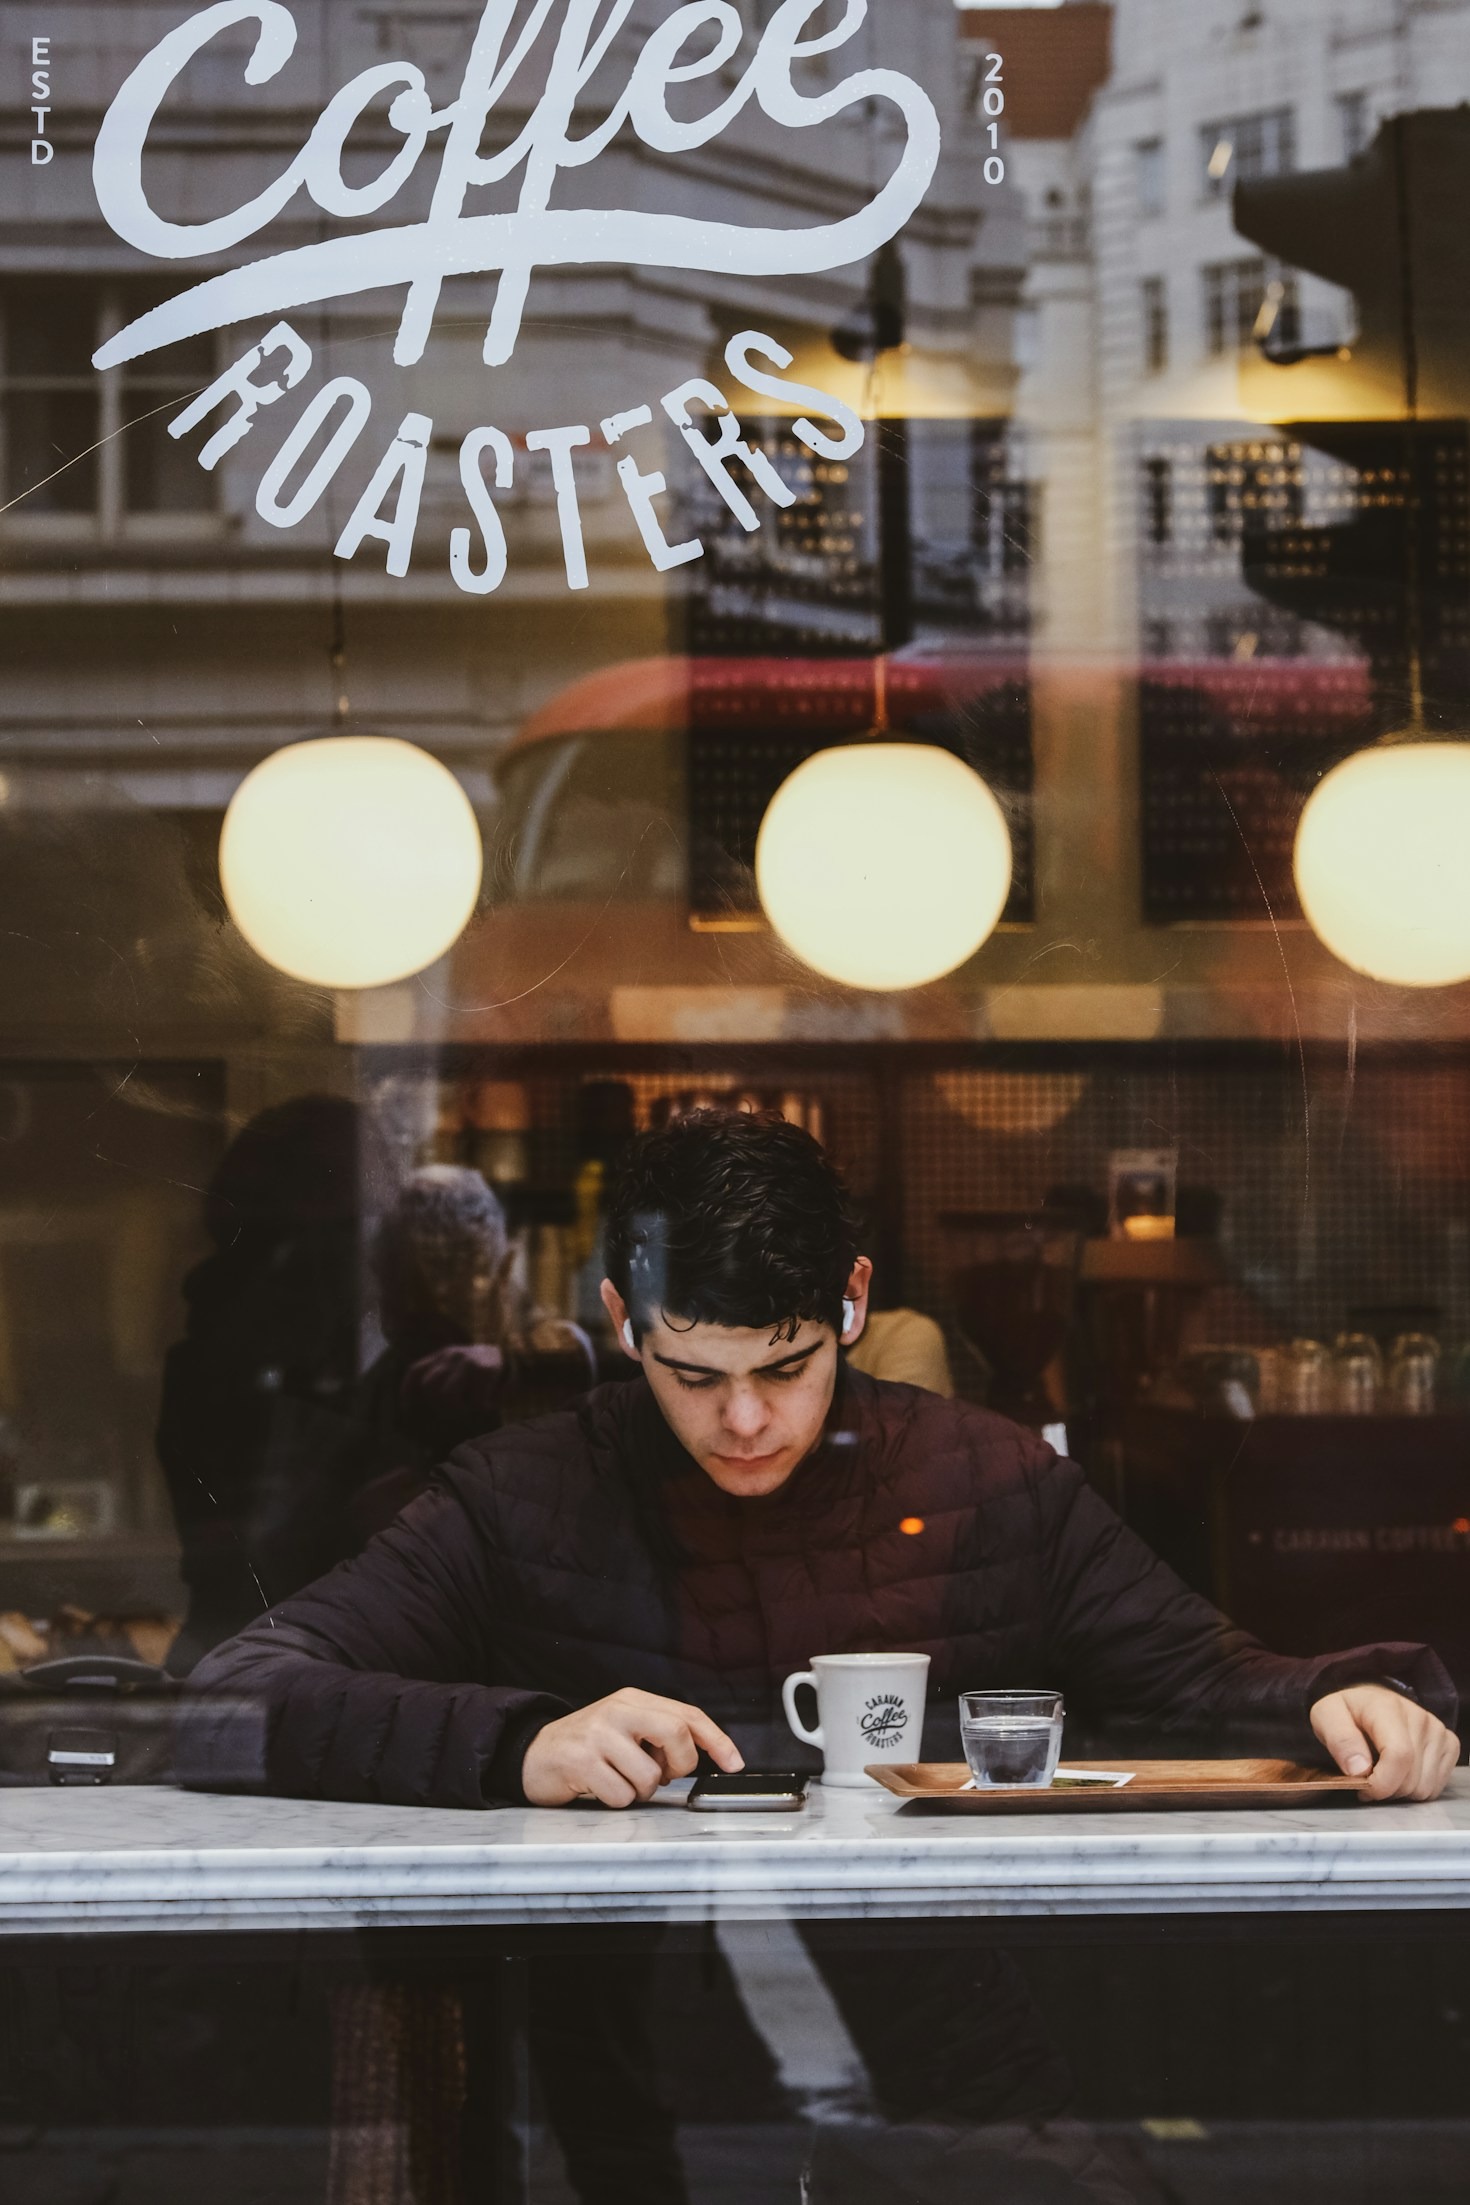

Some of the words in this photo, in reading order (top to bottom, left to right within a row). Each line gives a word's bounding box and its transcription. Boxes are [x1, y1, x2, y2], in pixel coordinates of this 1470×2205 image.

[30, 37, 54, 165] ESTD
[983, 53, 1005, 185] 2010
[92, 0, 942, 371] Coffee
[167, 320, 875, 595] ROASTERS
[861, 1707, 908, 1736] Coffee
[865, 1694, 904, 1710] CARAVAN
[865, 1731, 903, 1748] ROASTERS
